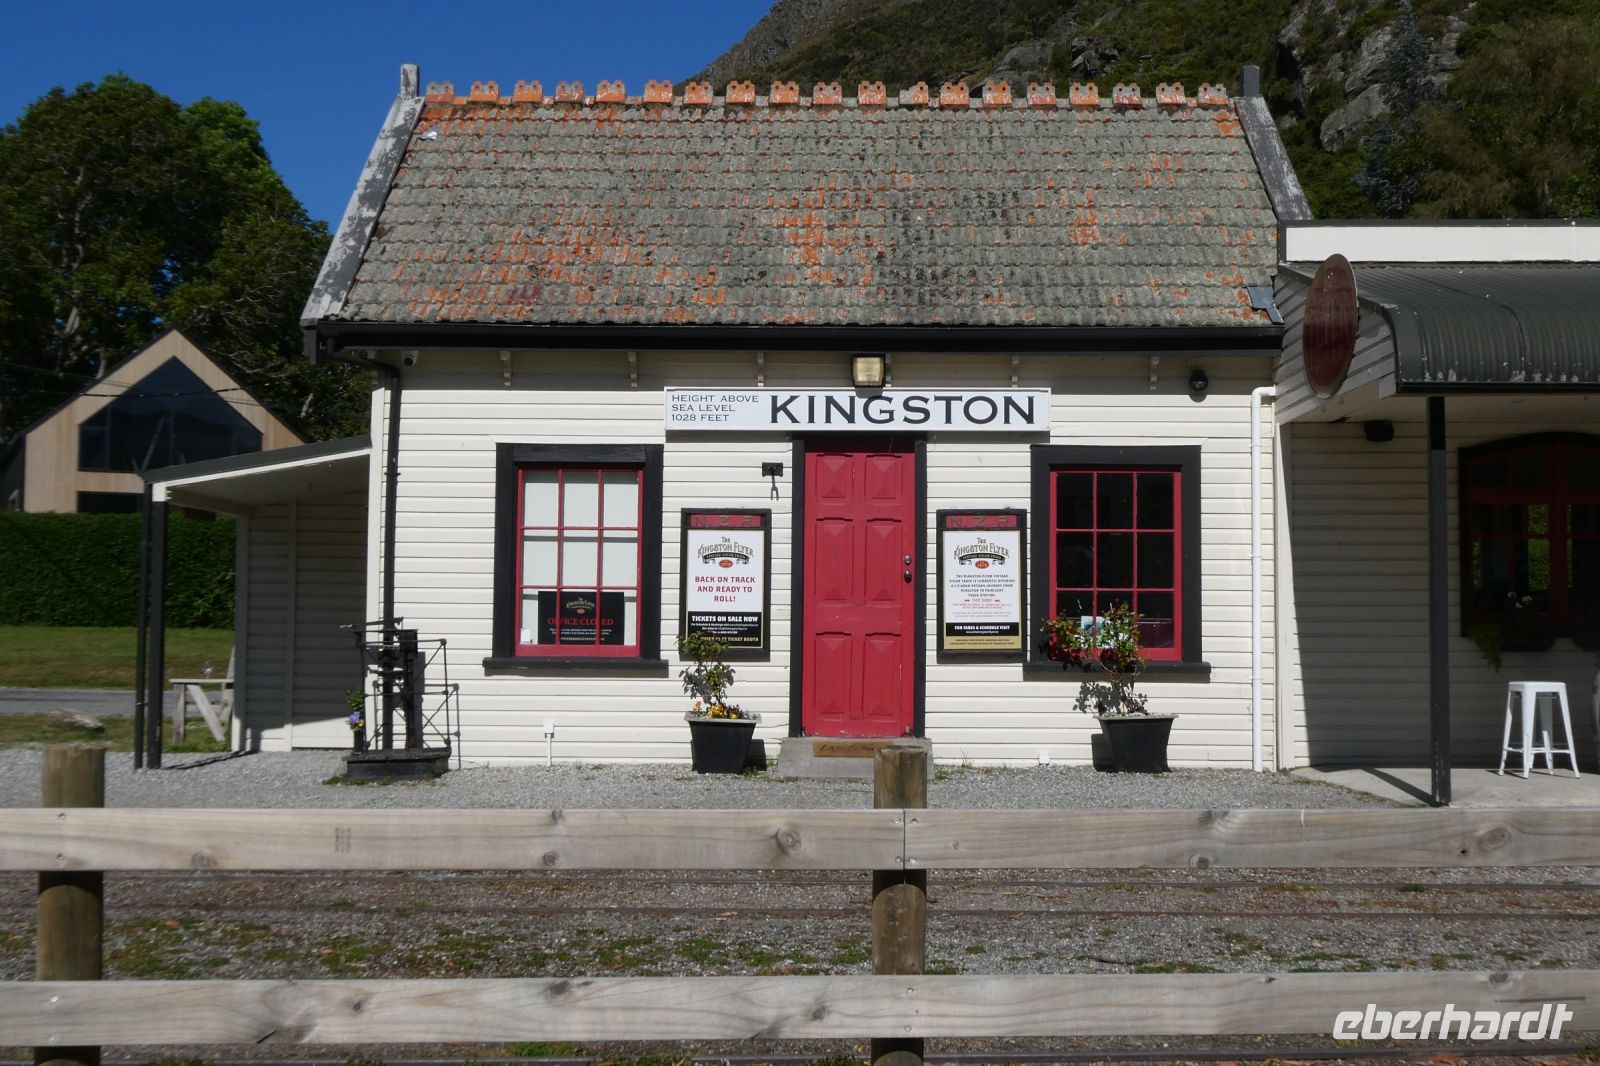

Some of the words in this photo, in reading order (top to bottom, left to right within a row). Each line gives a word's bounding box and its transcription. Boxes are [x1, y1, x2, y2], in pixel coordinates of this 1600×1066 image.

[671, 394, 715, 402] HEIGHT
[720, 394, 759, 403] ABOVE
[671, 404, 694, 412] SEA
[698, 404, 736, 412] LEVEL
[770, 395, 1035, 425] KINGSTON
[671, 414, 696, 422] 1028
[700, 414, 729, 422] FEET
[580, 618, 614, 626] CLOED
